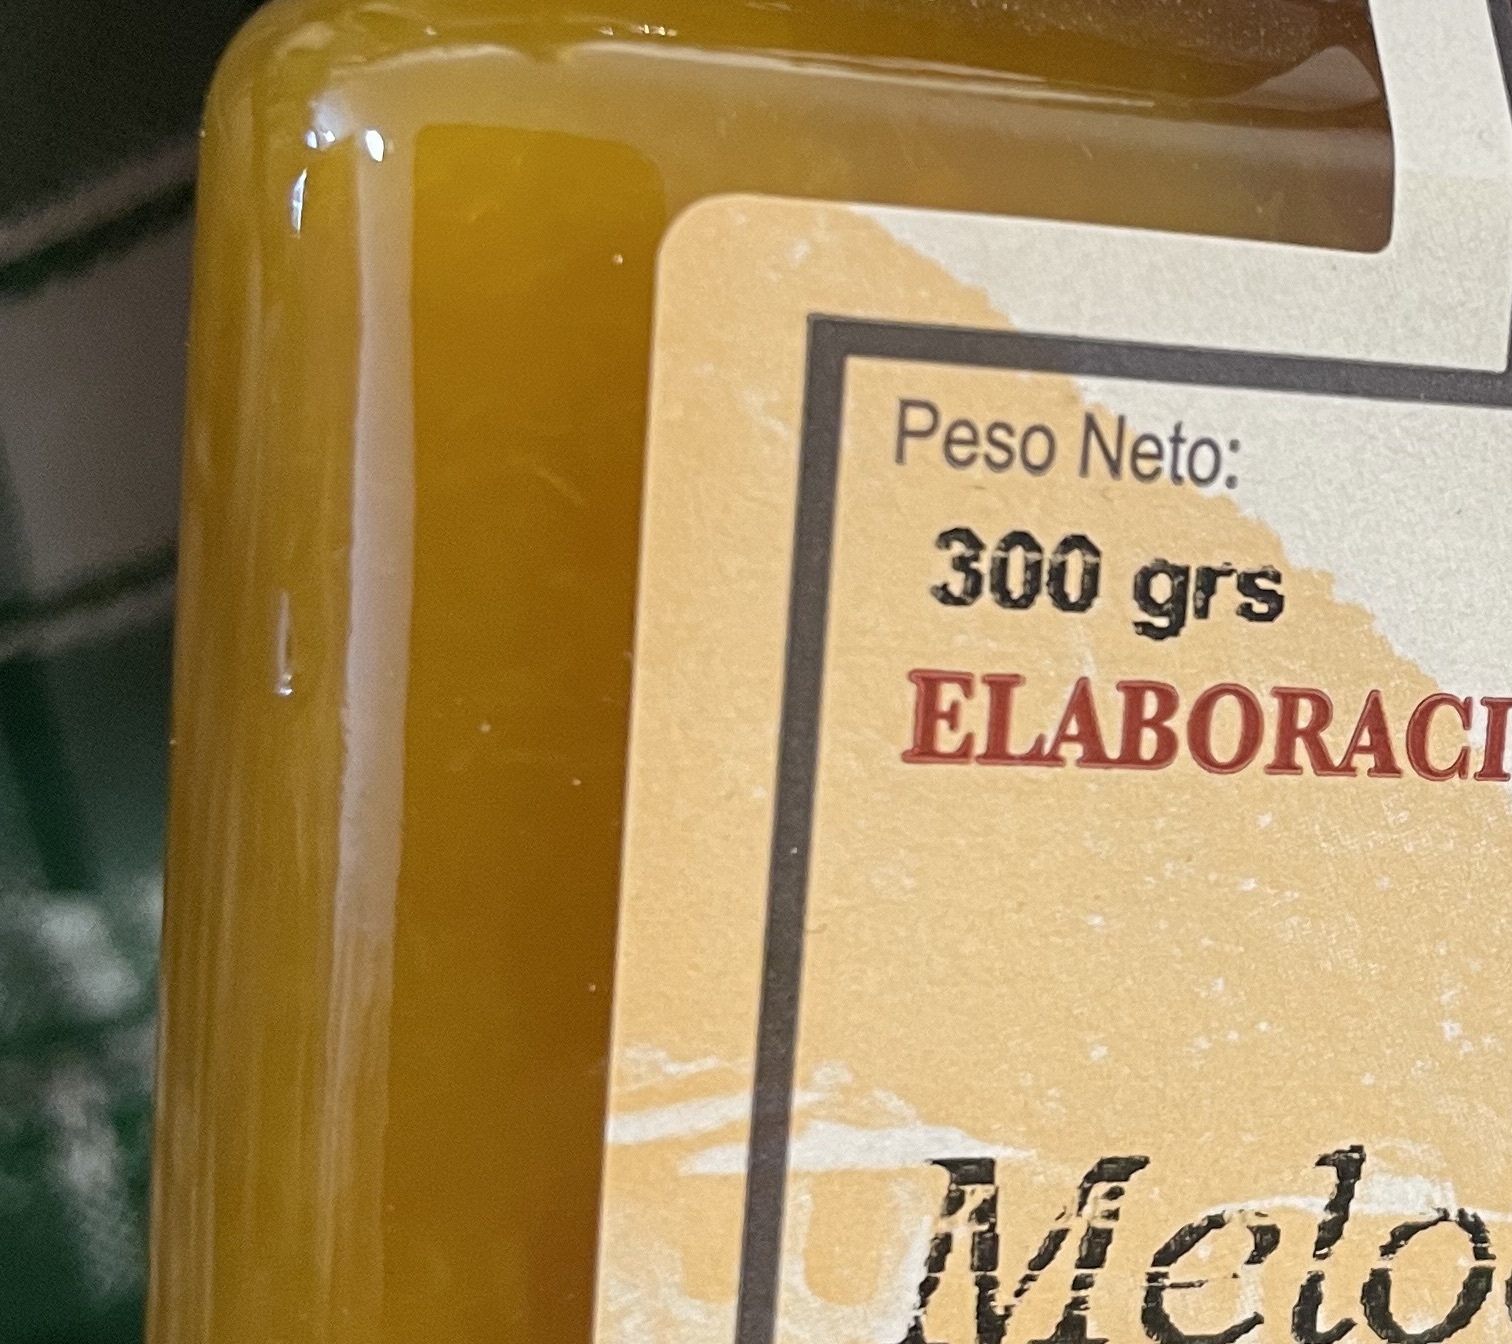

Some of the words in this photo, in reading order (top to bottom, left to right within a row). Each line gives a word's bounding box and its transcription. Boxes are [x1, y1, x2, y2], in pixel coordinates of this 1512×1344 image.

[895, 399, 1056, 475] Peso
[1080, 413, 1240, 489] Neto:
[930, 527, 1101, 613] 300
[1133, 558, 1285, 641] grs
